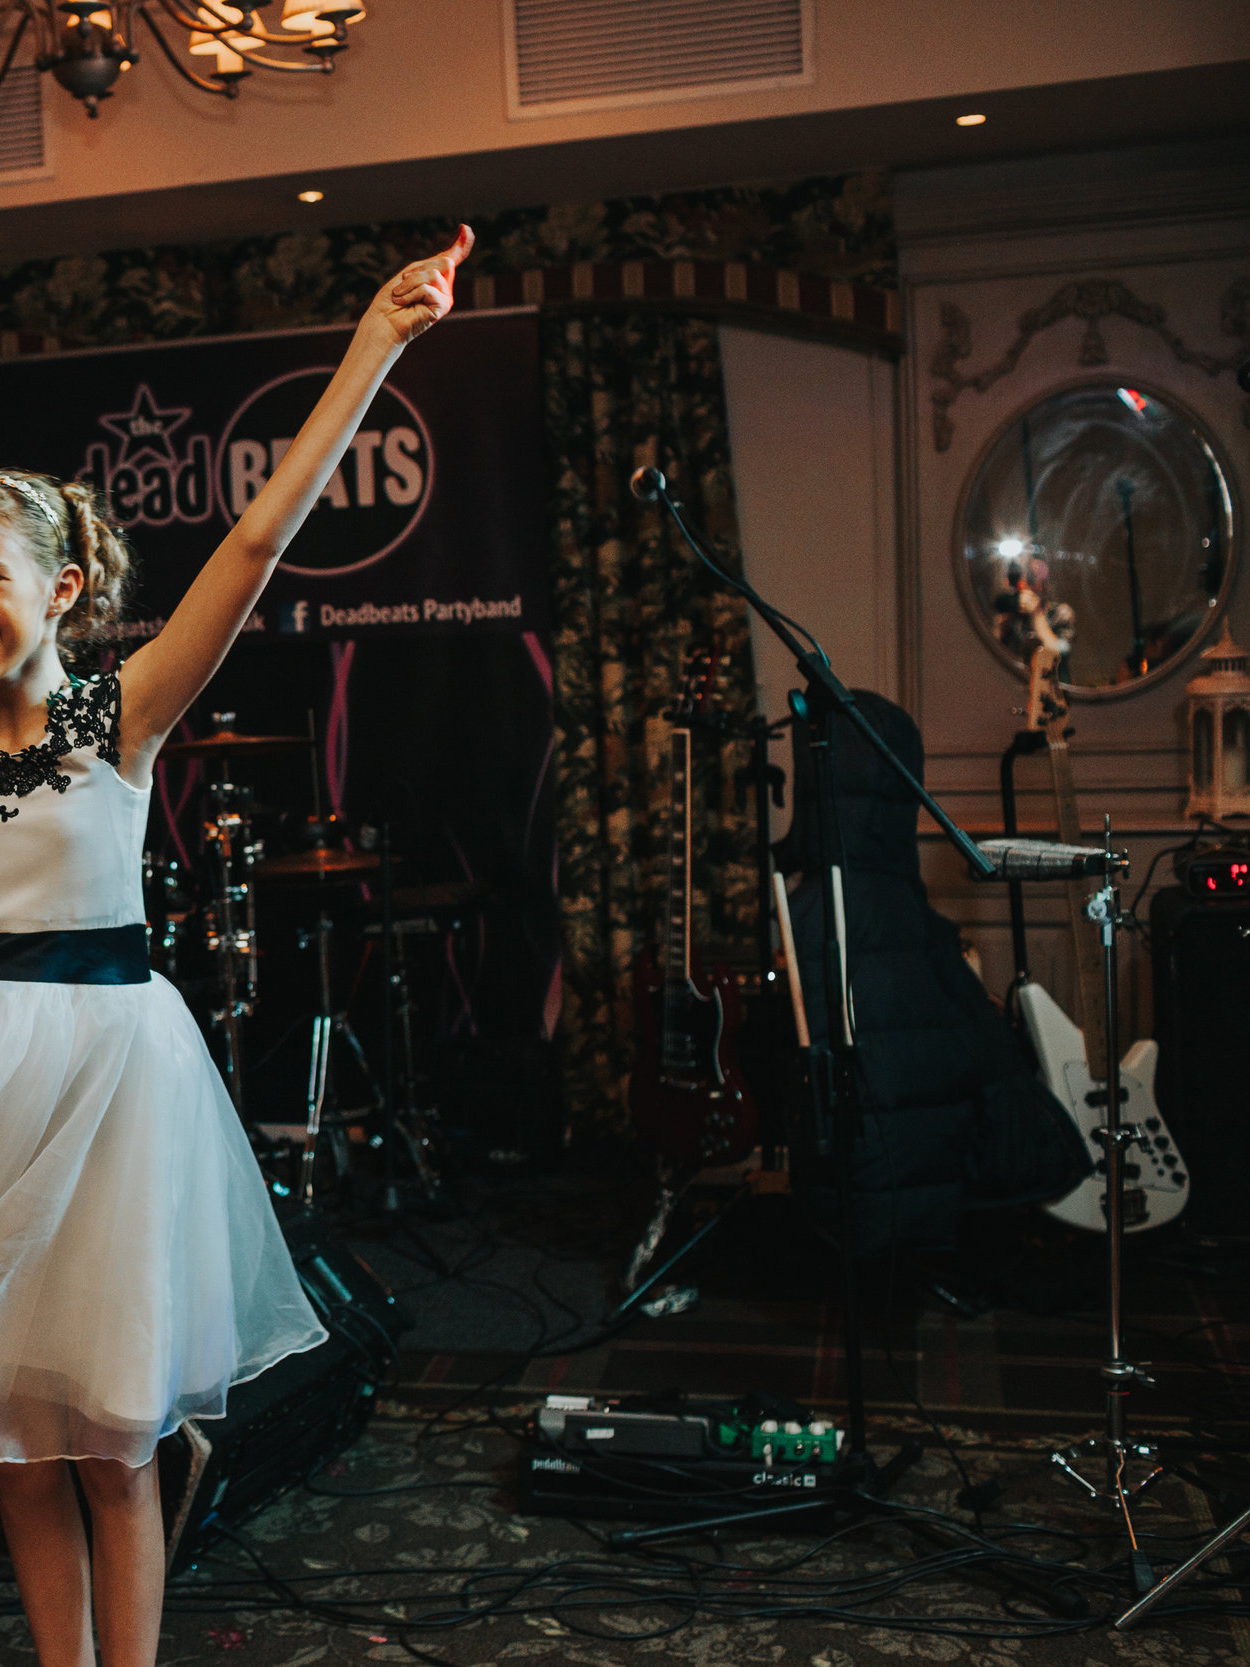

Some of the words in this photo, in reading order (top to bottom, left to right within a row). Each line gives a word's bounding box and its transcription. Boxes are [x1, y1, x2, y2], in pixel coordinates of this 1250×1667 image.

[129, 415, 164, 437] the
[319, 602, 421, 628] Deadbeats
[422, 593, 523, 627] Partyband
